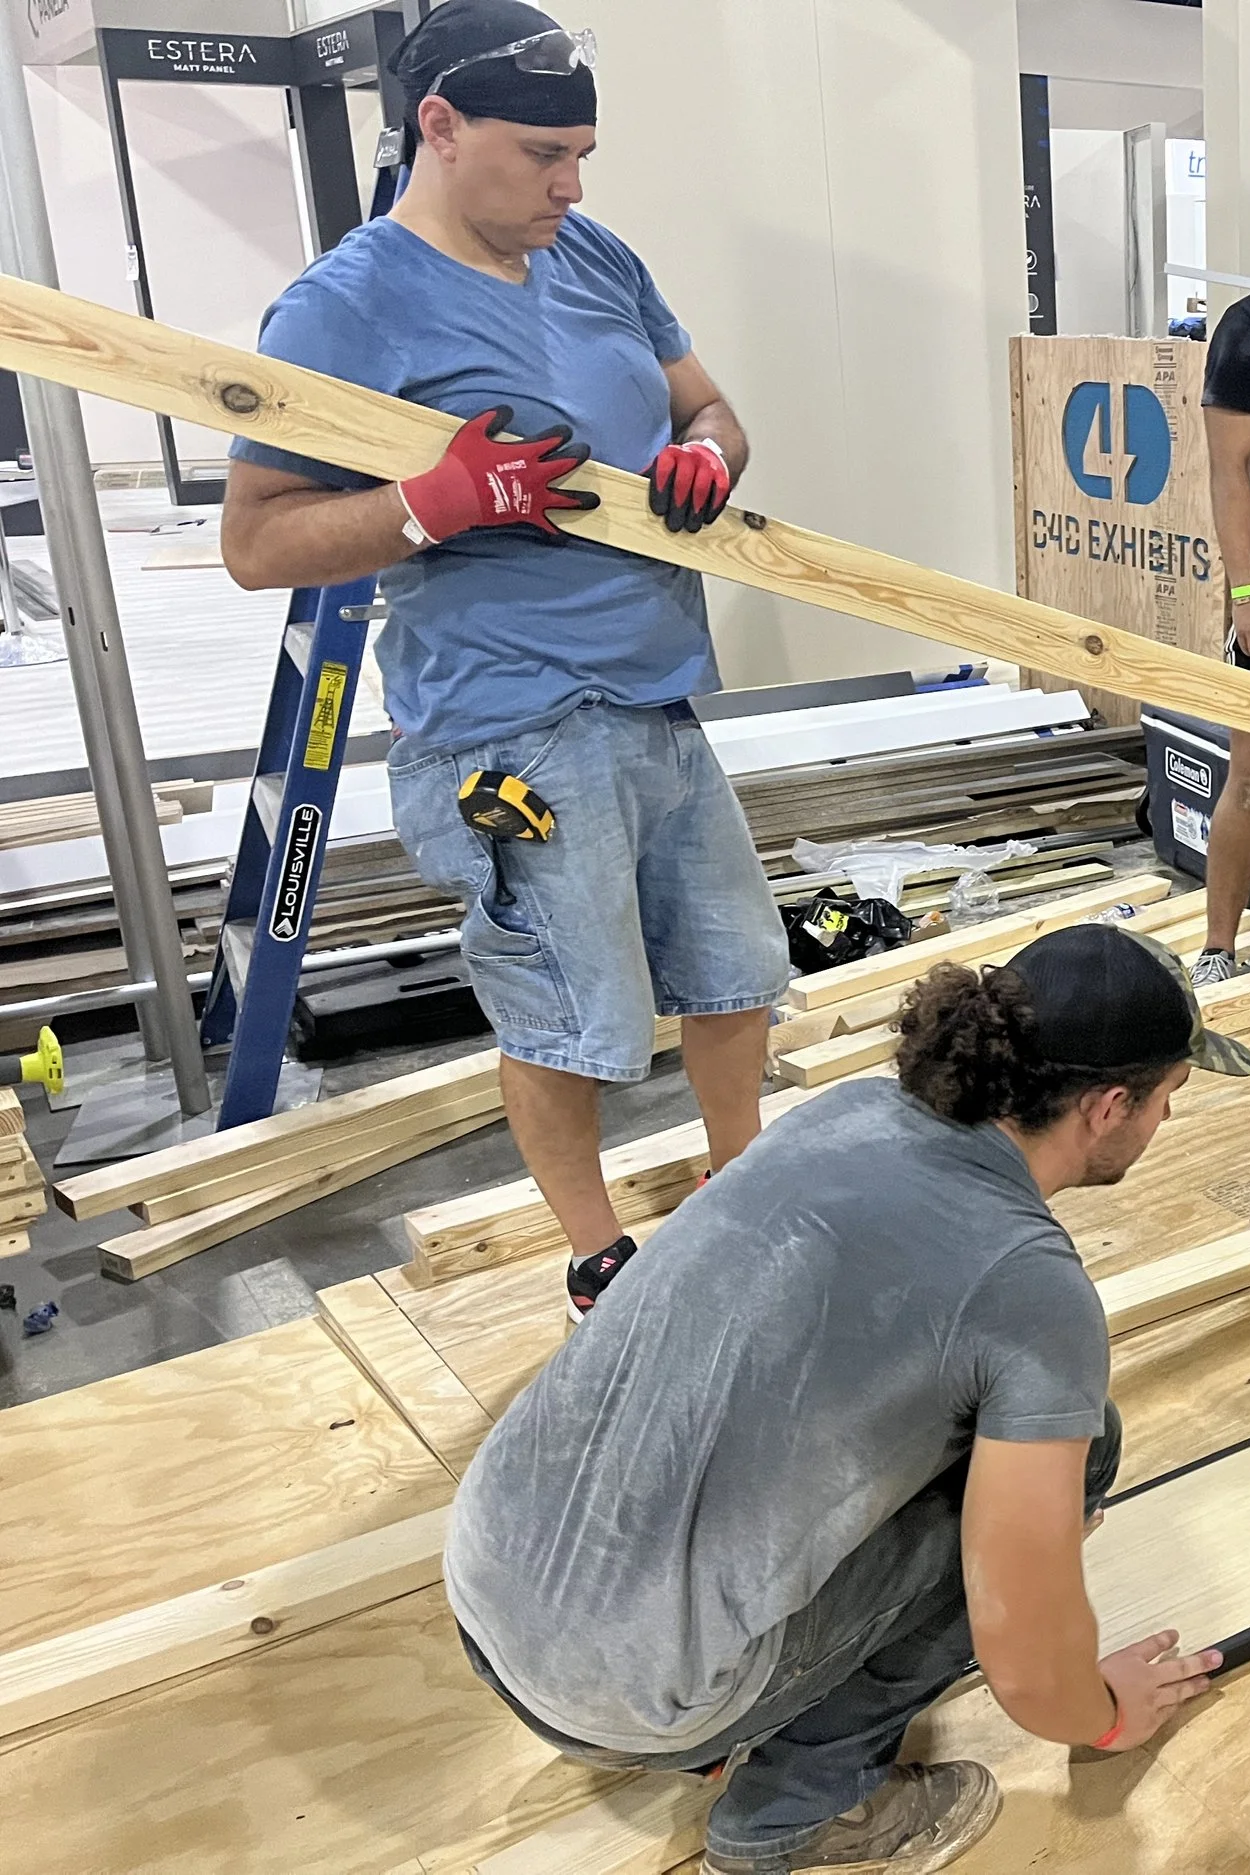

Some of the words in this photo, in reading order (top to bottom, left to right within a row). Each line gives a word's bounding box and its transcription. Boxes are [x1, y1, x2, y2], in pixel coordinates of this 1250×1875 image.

[148, 39, 257, 63] ESTERA
[316, 30, 350, 58] ESTERA
[173, 63, 200, 72] MATT
[203, 65, 235, 74] PANEL
[1155, 371, 1176, 382] APA
[1088, 519, 1211, 582] EXHIBITS
[1156, 583, 1176, 596] APA
[1169, 753, 1200, 783] Coleman
[281, 808, 314, 917] LOUISVILLE
